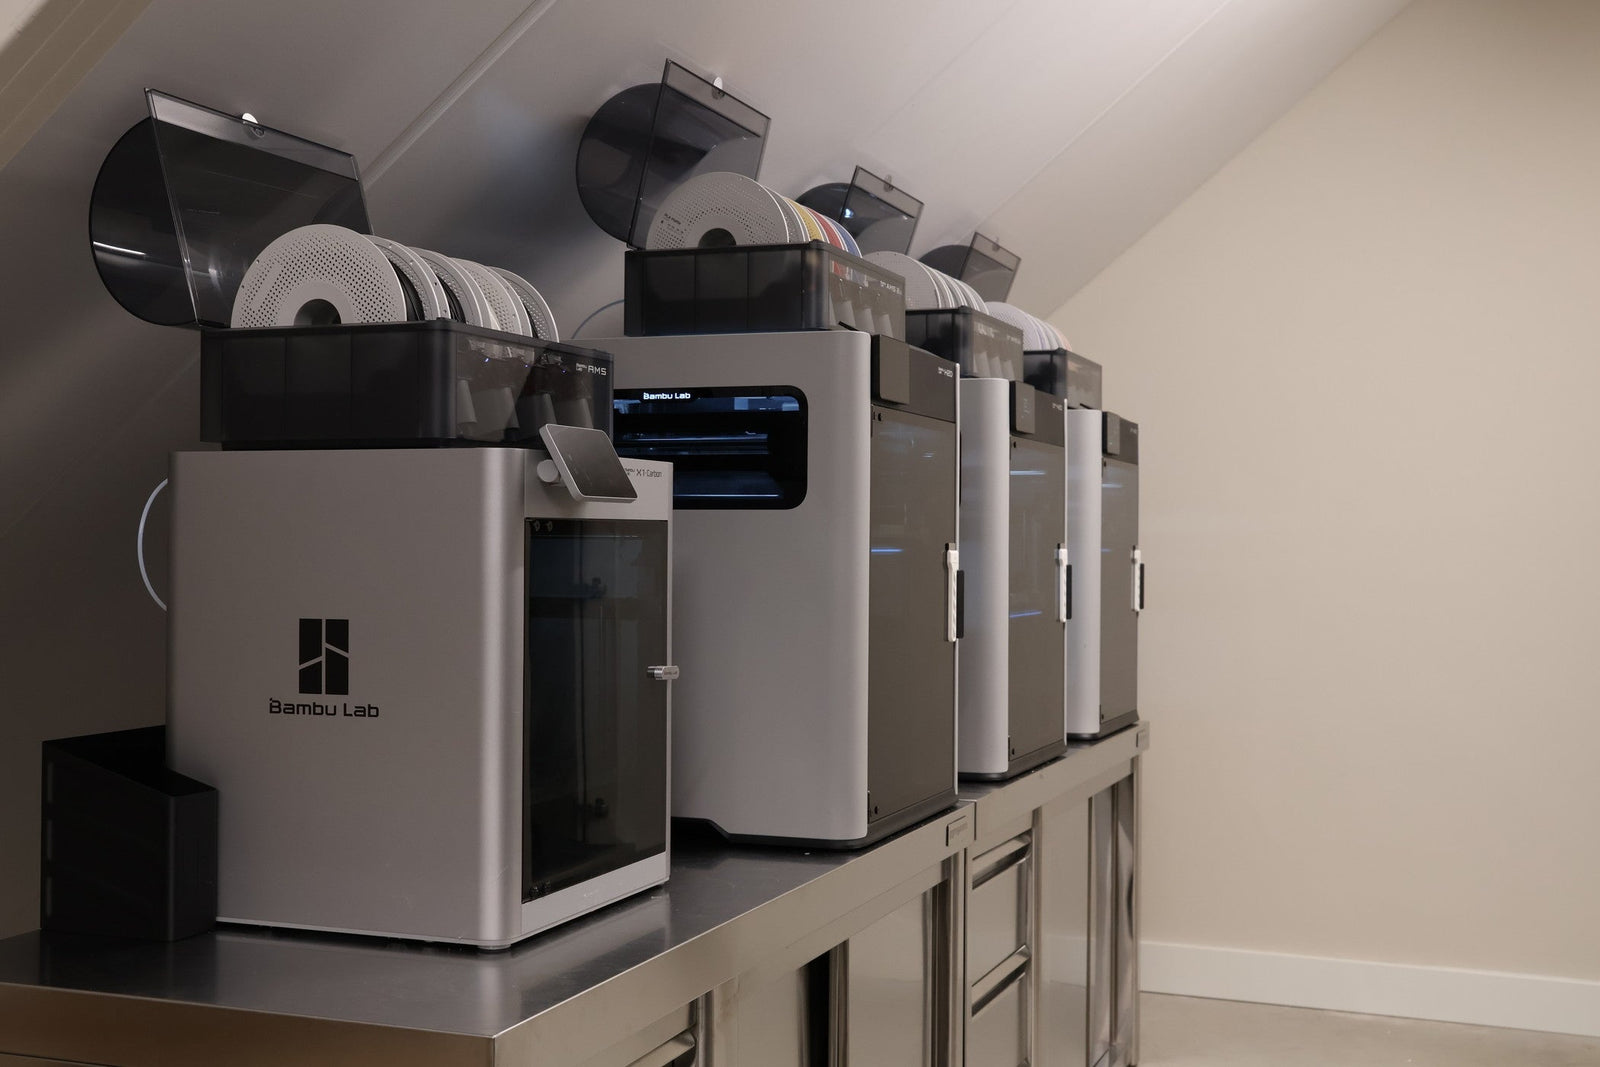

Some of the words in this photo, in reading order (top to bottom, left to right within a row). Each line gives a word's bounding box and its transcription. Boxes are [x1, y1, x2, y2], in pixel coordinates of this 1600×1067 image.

[587, 365, 607, 376] AMS
[643, 392, 673, 400] Bambu
[674, 392, 691, 400] Lab
[269, 698, 337, 716] Bambu
[343, 702, 380, 718] Lab
